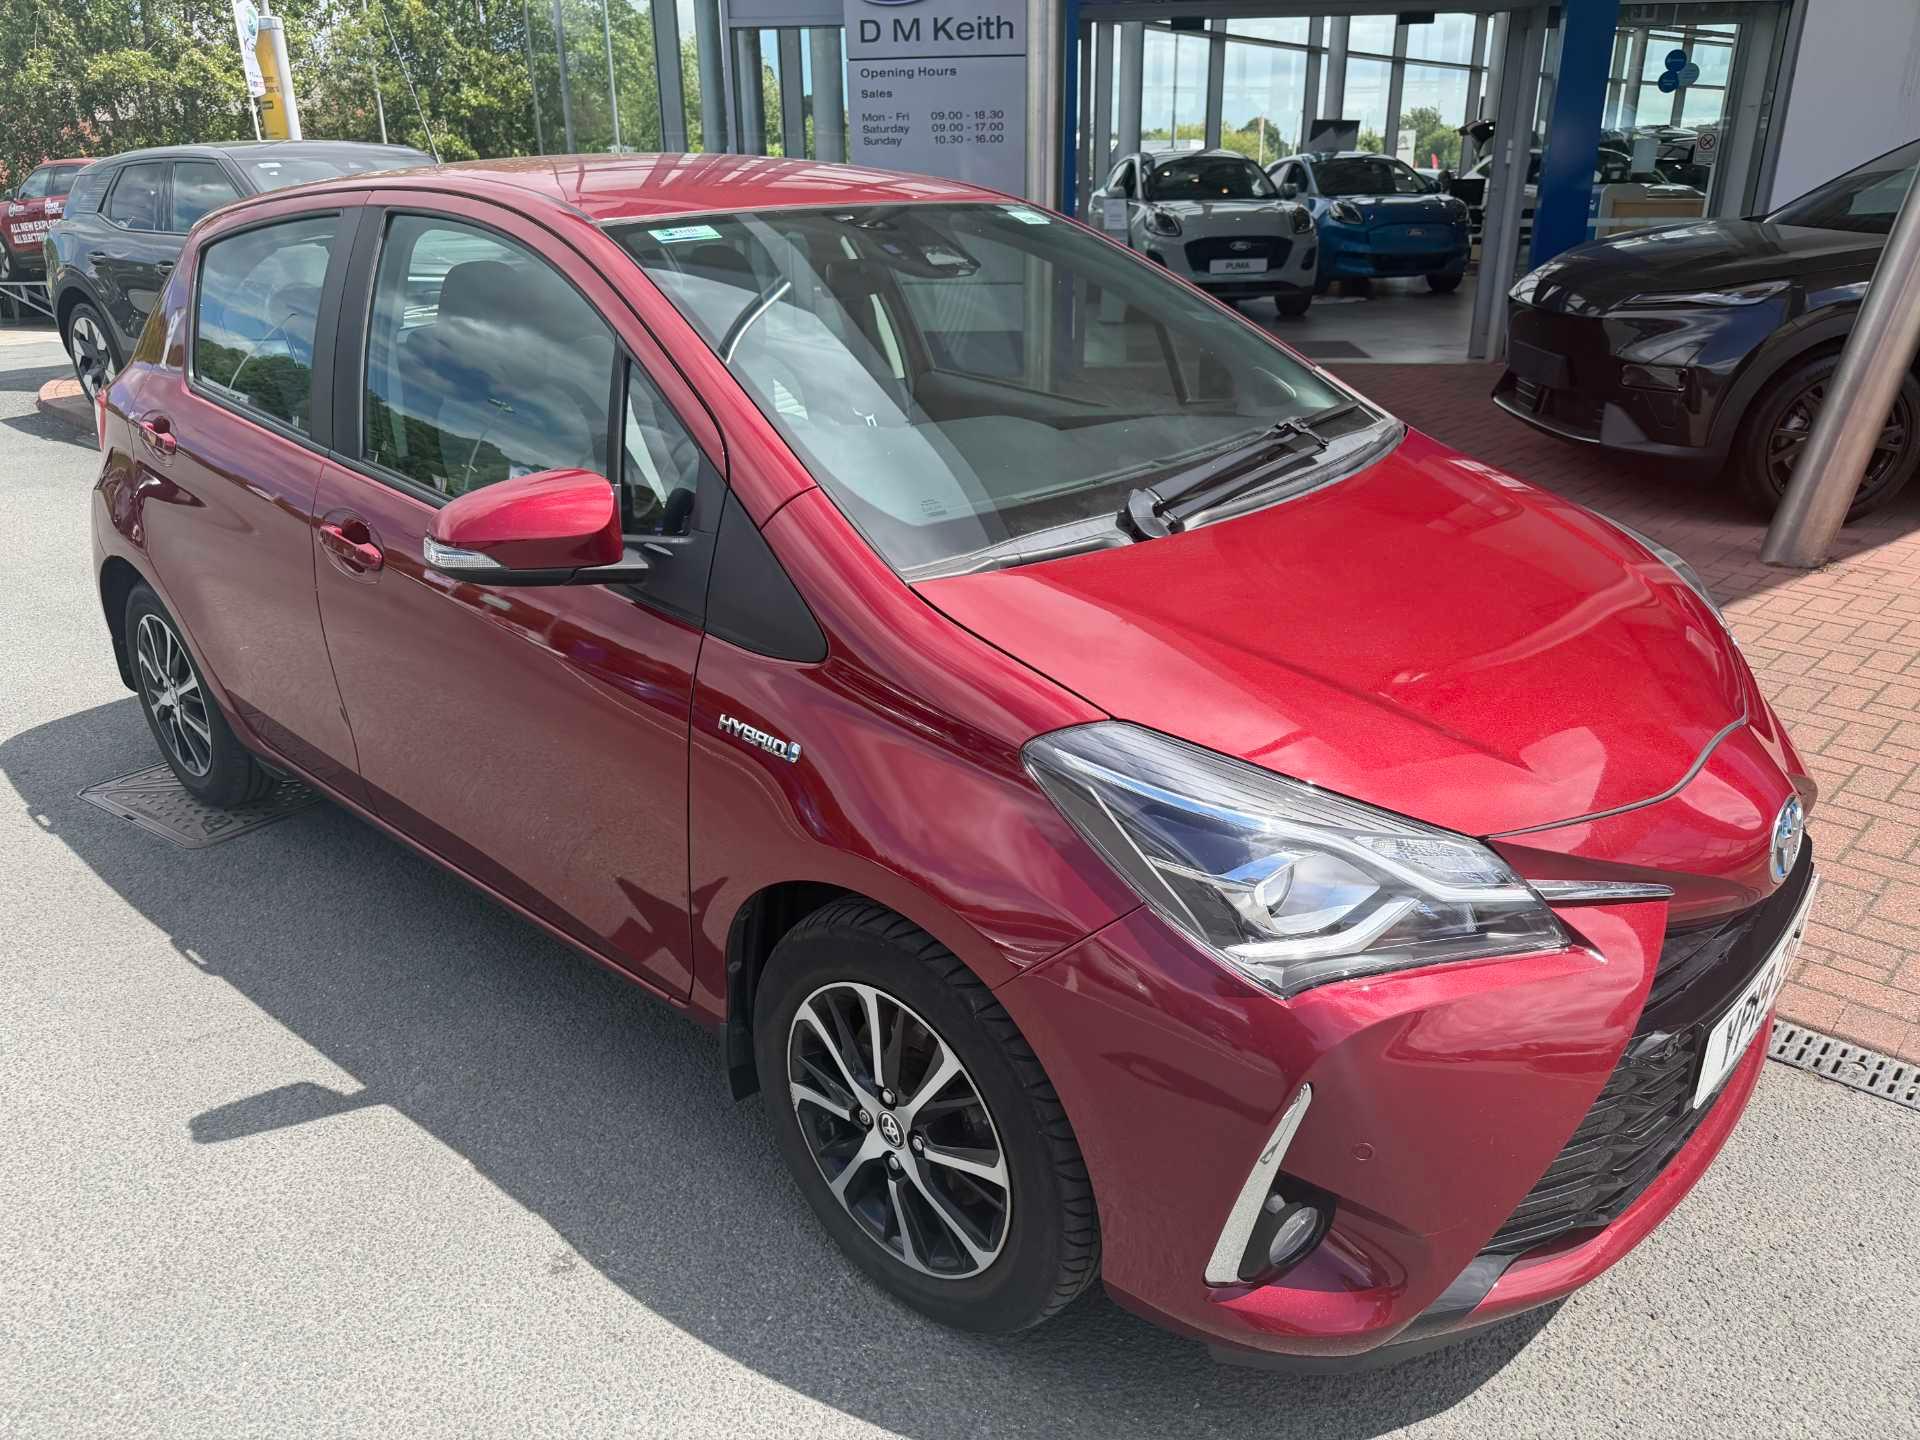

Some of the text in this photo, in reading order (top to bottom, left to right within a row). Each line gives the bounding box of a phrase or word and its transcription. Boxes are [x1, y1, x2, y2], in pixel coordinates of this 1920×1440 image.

[860, 15, 1014, 43] D M Keith
[860, 66, 957, 79] Opening Hours
[861, 89, 893, 99] Sales
[862, 112, 885, 122] Mon
[896, 112, 910, 121] Fri
[931, 111, 962, 121] 09.00
[974, 110, 1004, 120] 18.30
[862, 124, 910, 135] Saturday
[931, 123, 964, 132] 09.00
[975, 122, 1004, 131] 17.00
[863, 136, 902, 147] Sunday
[935, 135, 964, 144] 10.30
[20, 222, 33, 232] NEW
[1225, 261, 1250, 270] PUMA
[718, 713, 787, 759] HYBRID
